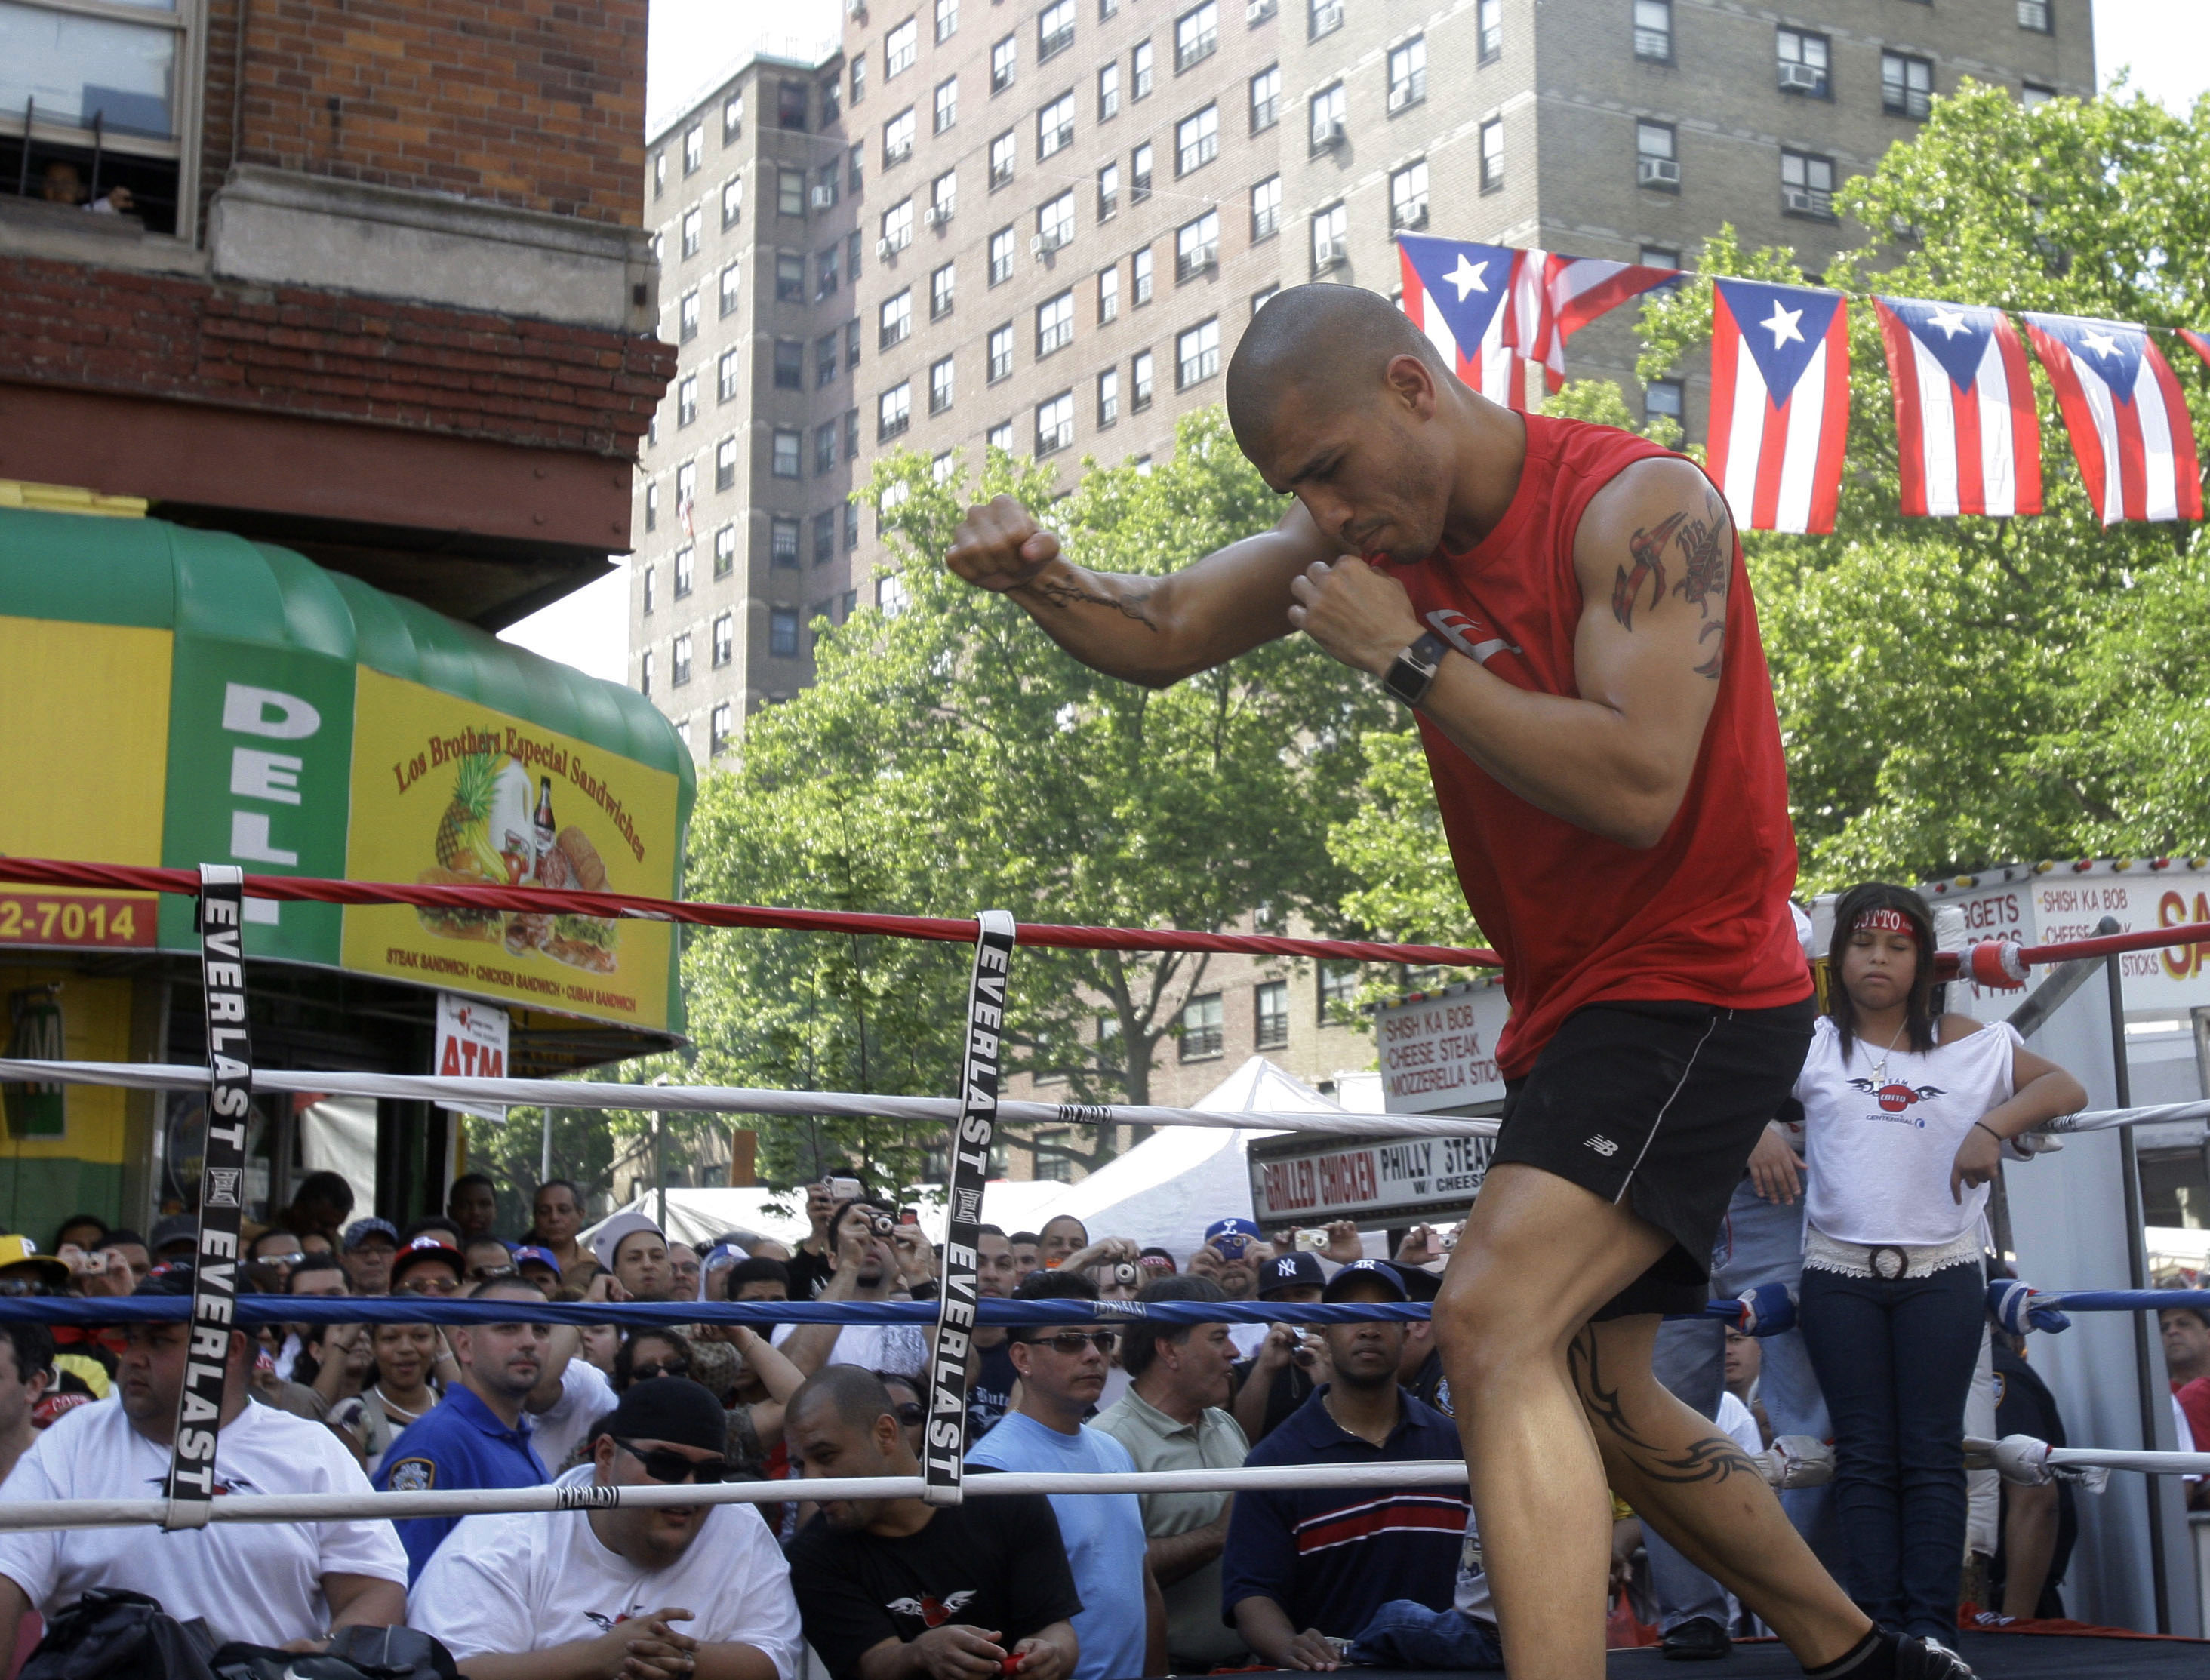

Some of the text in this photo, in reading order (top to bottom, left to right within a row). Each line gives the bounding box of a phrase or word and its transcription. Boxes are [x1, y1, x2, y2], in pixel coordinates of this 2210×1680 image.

[392, 725, 646, 863] Los Brothers Especial Sandwiches
[0, 900, 137, 941] 2-7014
[2043, 888, 2128, 913] SHISH KA BOB
[386, 947, 636, 1013] STEAK SANDWICH CHICKEN SANDWICH CUBAN SANDWICH
[2122, 953, 2159, 977] STICKS
[205, 897, 250, 1151] EVERLAST
[1386, 1005, 1474, 1042] SHISH KA BOB
[959, 944, 1009, 1176] EVERLAST
[1387, 1034, 1480, 1070] CHEESE STEAK
[1319, 1151, 1378, 1206] CHICKEN
[1380, 1142, 1433, 1183] PHILLY
[176, 1228, 237, 1494] EVERLAST
[928, 1241, 977, 1481] EVERLAST
